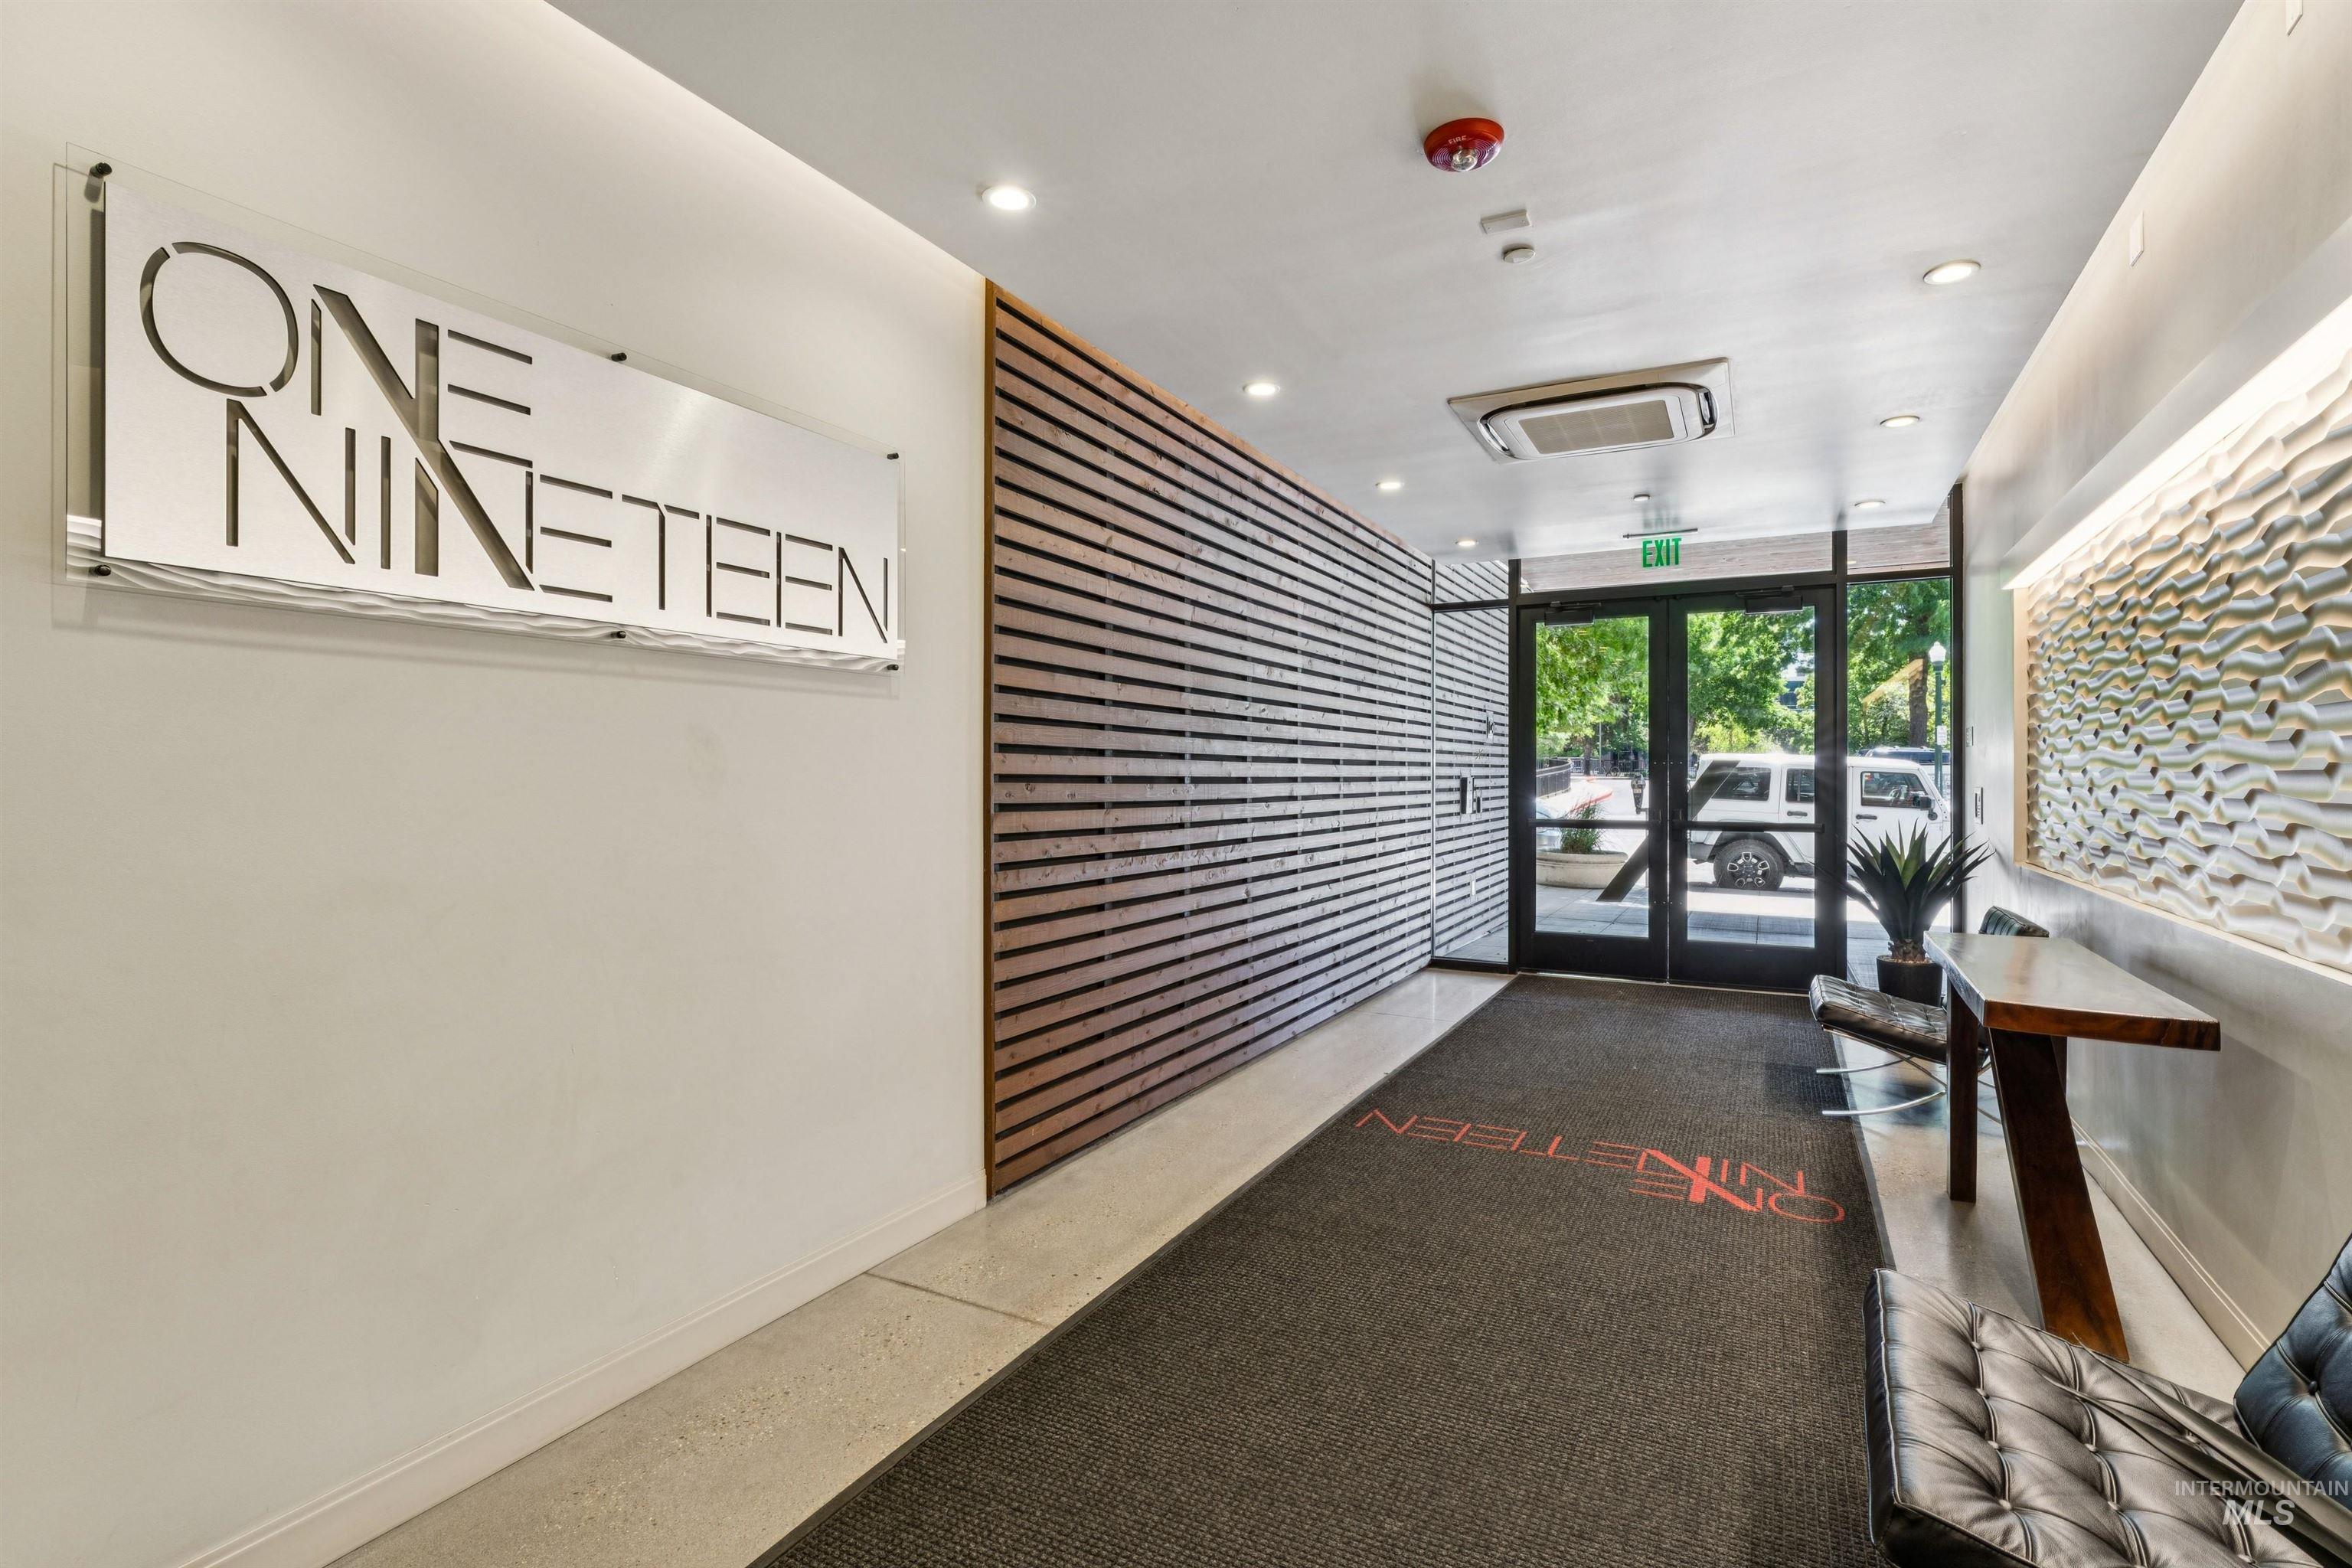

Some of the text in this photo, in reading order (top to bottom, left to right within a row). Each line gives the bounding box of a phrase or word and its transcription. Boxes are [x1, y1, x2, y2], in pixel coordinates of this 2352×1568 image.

[1448, 135, 1467, 145] FIRE
[139, 241, 533, 468] ONE
[225, 397, 889, 644] NINETEEN
[1642, 537, 1682, 567] EXIT
[1628, 1169, 1845, 1223] ONE
